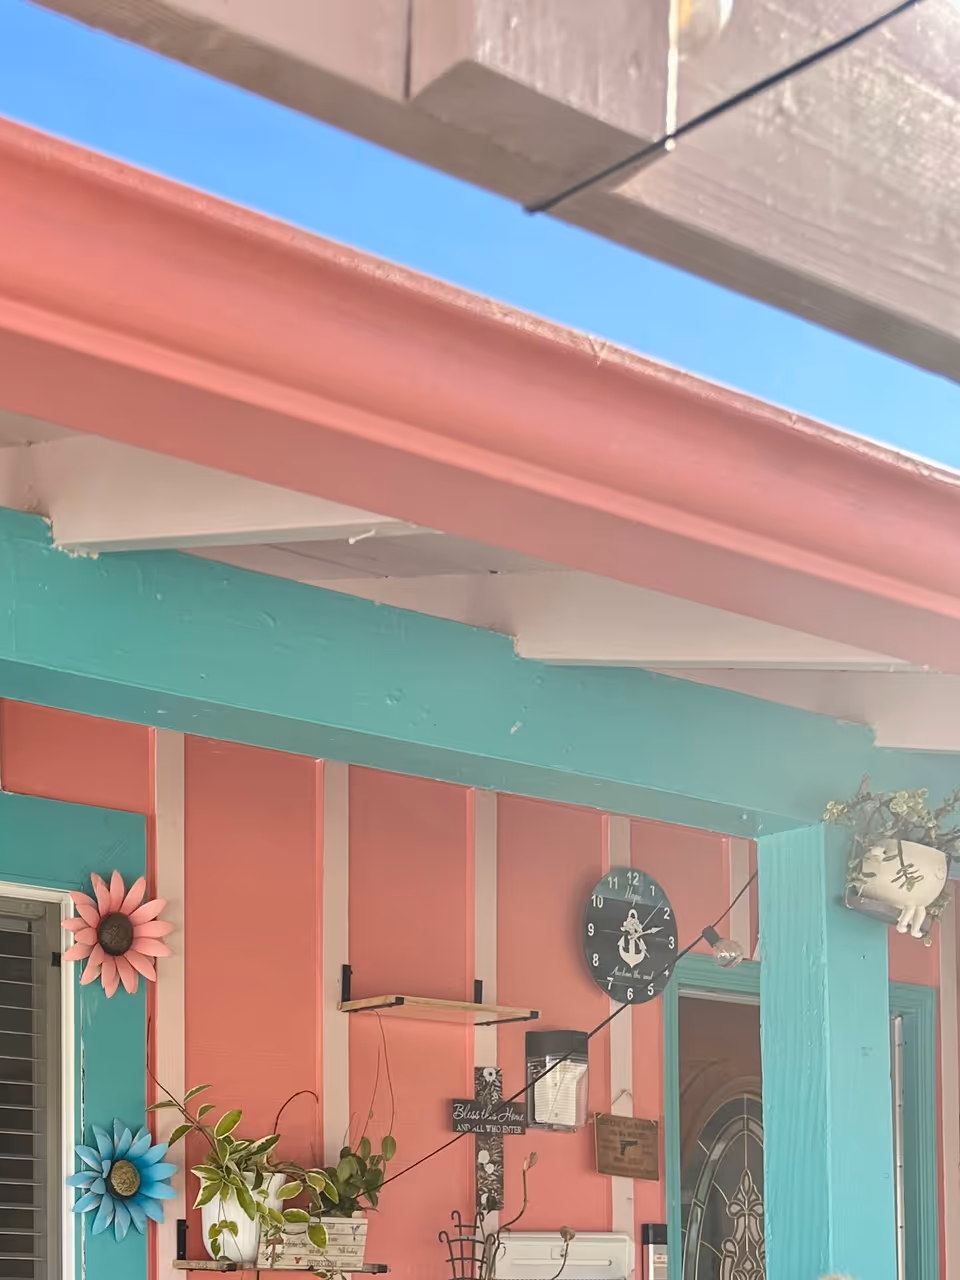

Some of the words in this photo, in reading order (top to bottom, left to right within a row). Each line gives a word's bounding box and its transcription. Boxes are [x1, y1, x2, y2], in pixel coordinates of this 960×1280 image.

[607, 876, 618, 889] 11
[626, 871, 640, 886] 12
[650, 885, 655, 896] 1
[591, 894, 604, 909] 10
[663, 907, 670, 920] 2
[587, 923, 595, 936] 9
[668, 936, 675, 949] 3
[592, 953, 599, 967] 8
[663, 964, 670, 977] 4
[607, 977, 613, 990] 7
[647, 983, 654, 995] 5
[627, 988, 634, 1000] 6
[452, 1103, 480, 1120] Bless
[498, 1107, 525, 1122] Home
[456, 1123, 471, 1132] AND
[486, 1124, 501, 1133] WHO
[502, 1125, 522, 1134] ENTER
